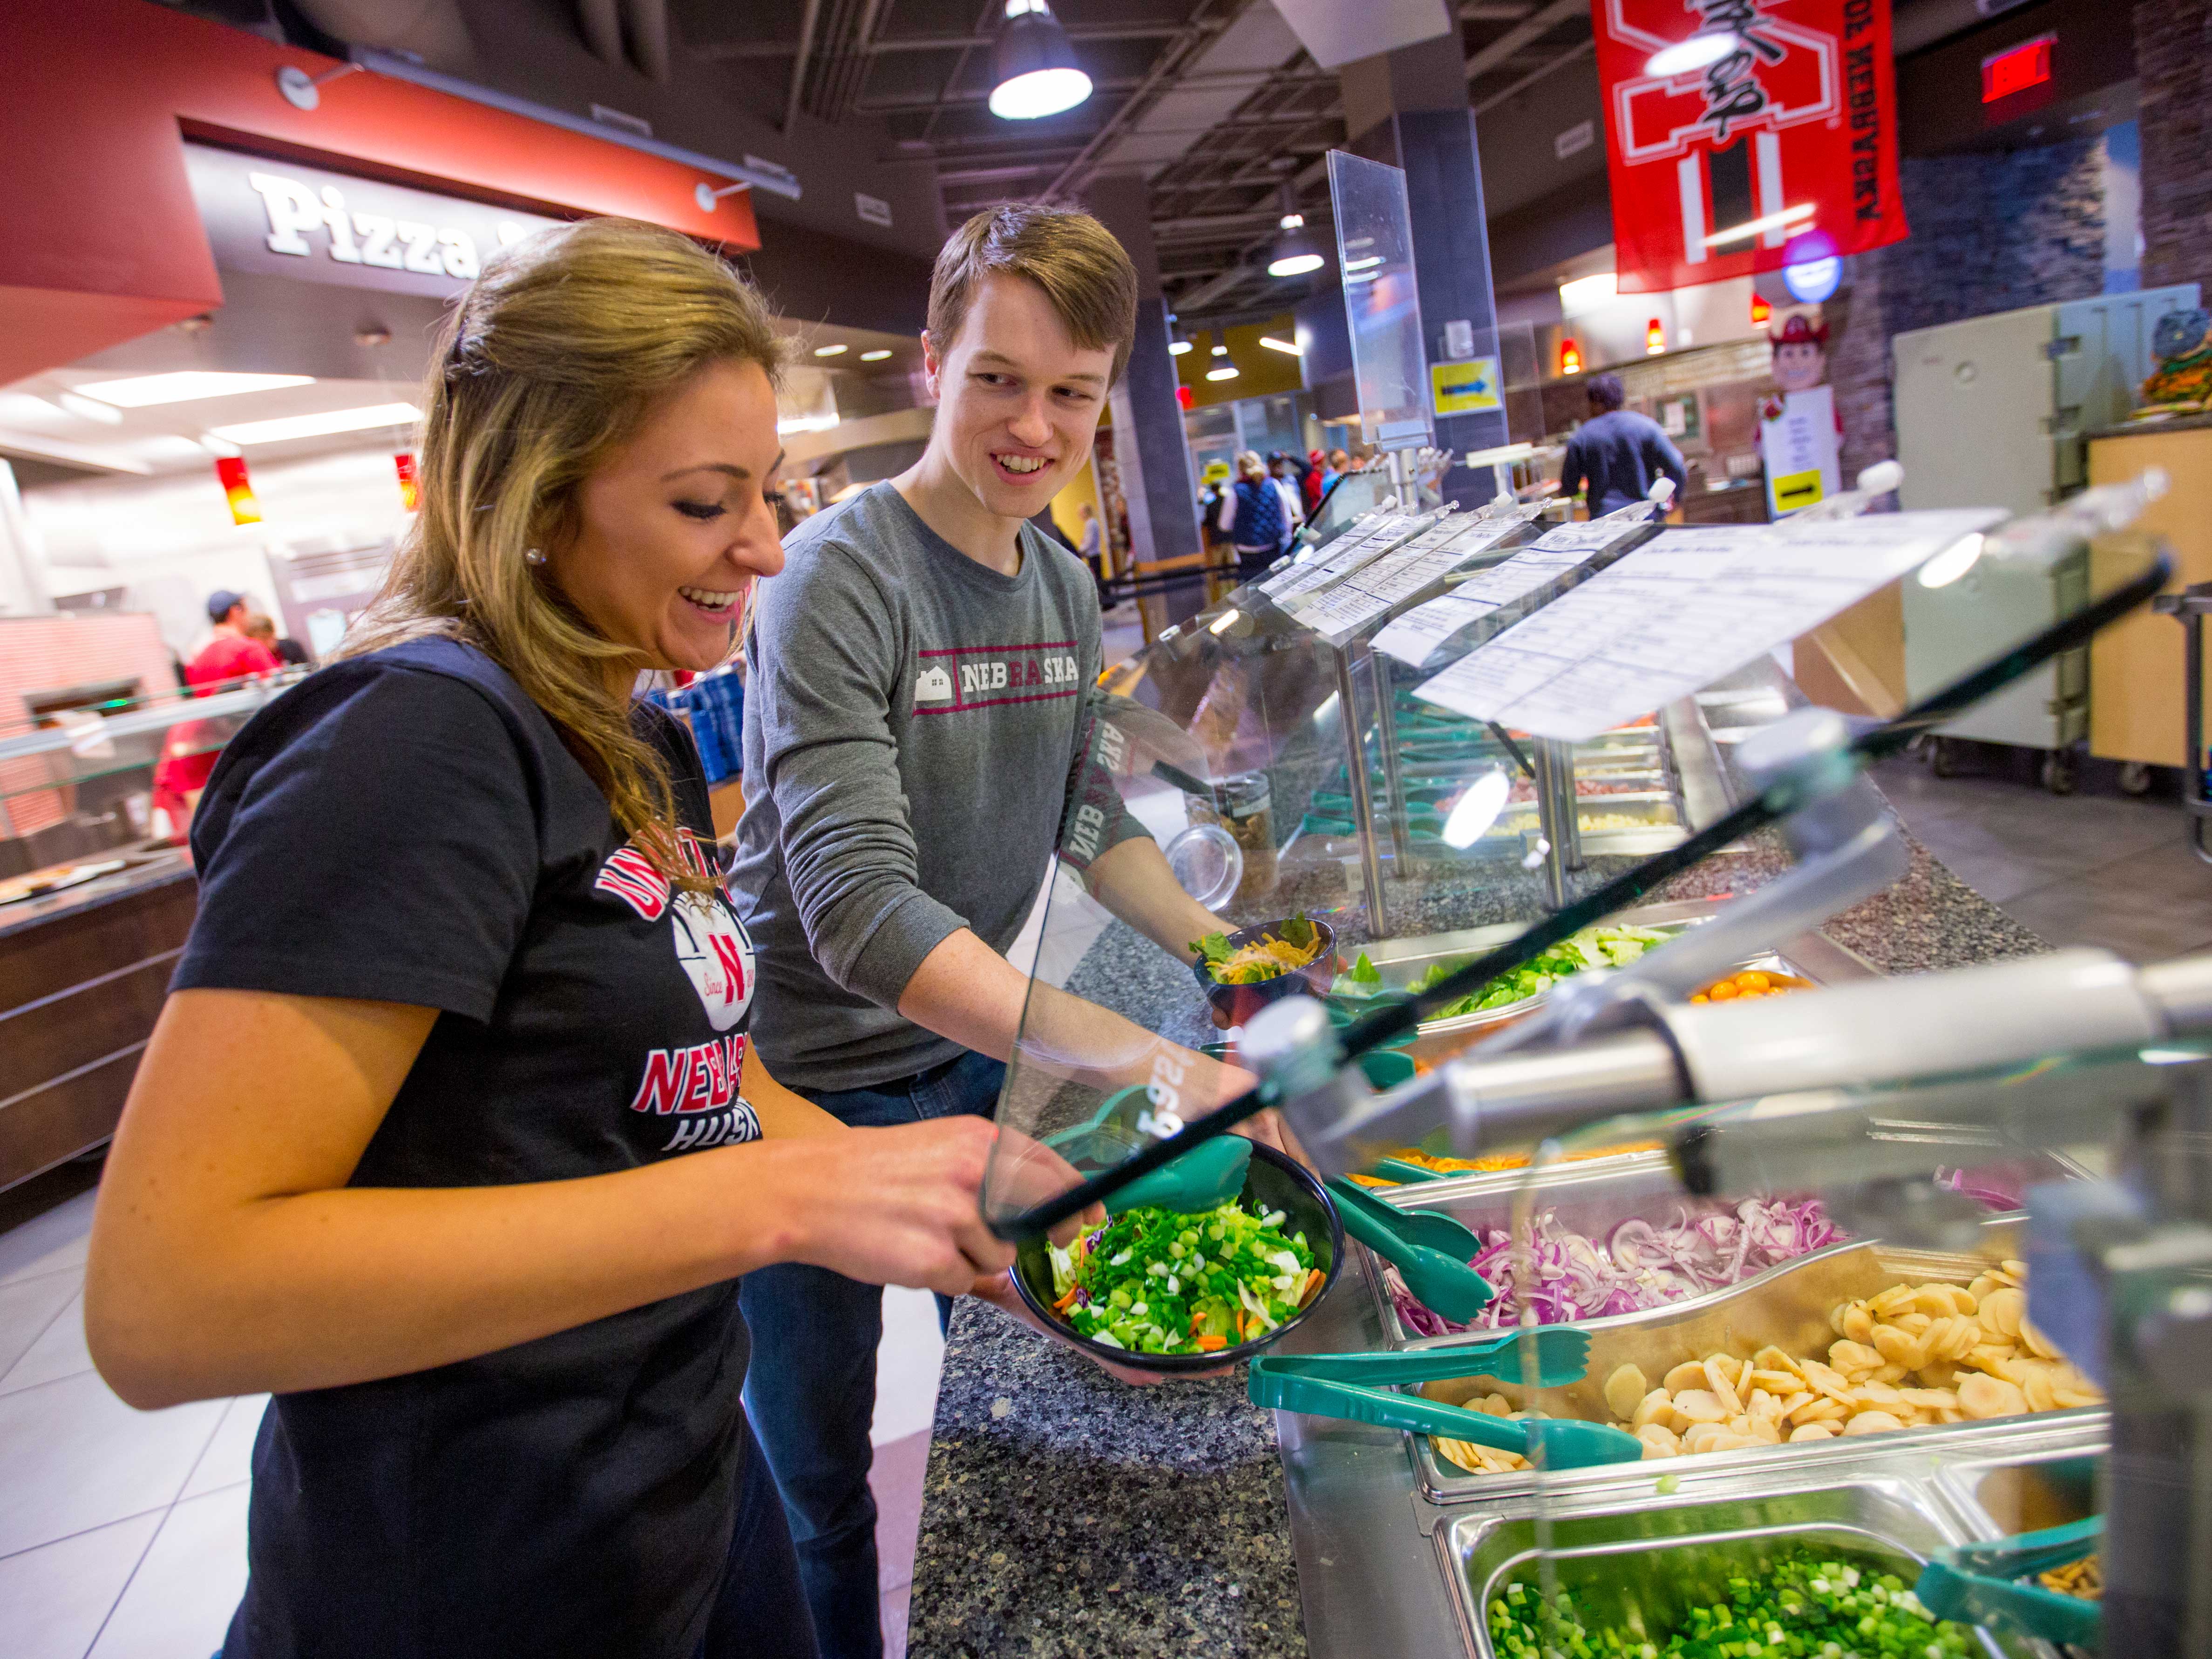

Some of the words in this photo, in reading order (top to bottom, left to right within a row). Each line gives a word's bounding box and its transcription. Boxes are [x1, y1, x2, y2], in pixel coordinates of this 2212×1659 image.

[250, 171, 480, 279] Pizza
[961, 656, 1079, 692] NEBRASKA
[704, 971, 723, 996] Since
[706, 932, 745, 1007] N
